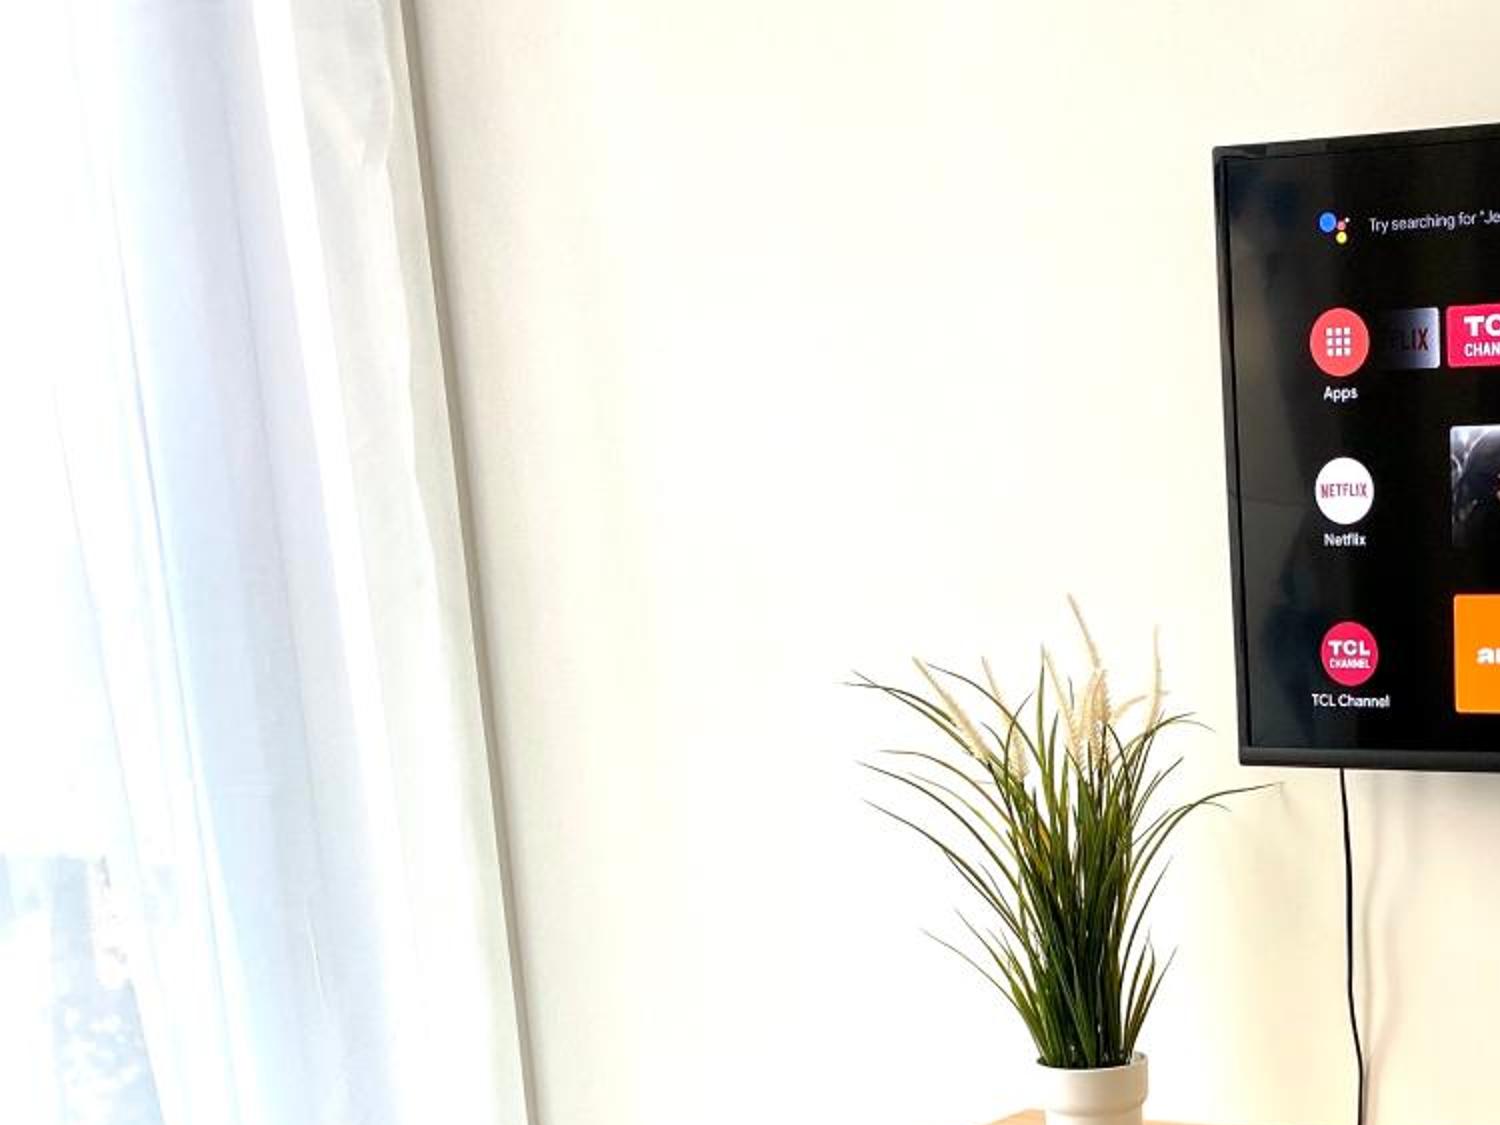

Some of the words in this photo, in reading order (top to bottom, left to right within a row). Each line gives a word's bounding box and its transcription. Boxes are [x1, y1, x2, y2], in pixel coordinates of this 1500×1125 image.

[1369, 217, 1389, 235] Try
[1391, 213, 1455, 231] searching
[1458, 211, 1477, 225] for
[1323, 385, 1359, 403] Apps
[1320, 482, 1369, 499] NETFLIX
[1323, 532, 1367, 547] Netflix
[1328, 639, 1371, 656] TCL
[1329, 658, 1371, 669] CHANNEL
[1311, 693, 1337, 707] TCL
[1338, 693, 1391, 708] Channel
